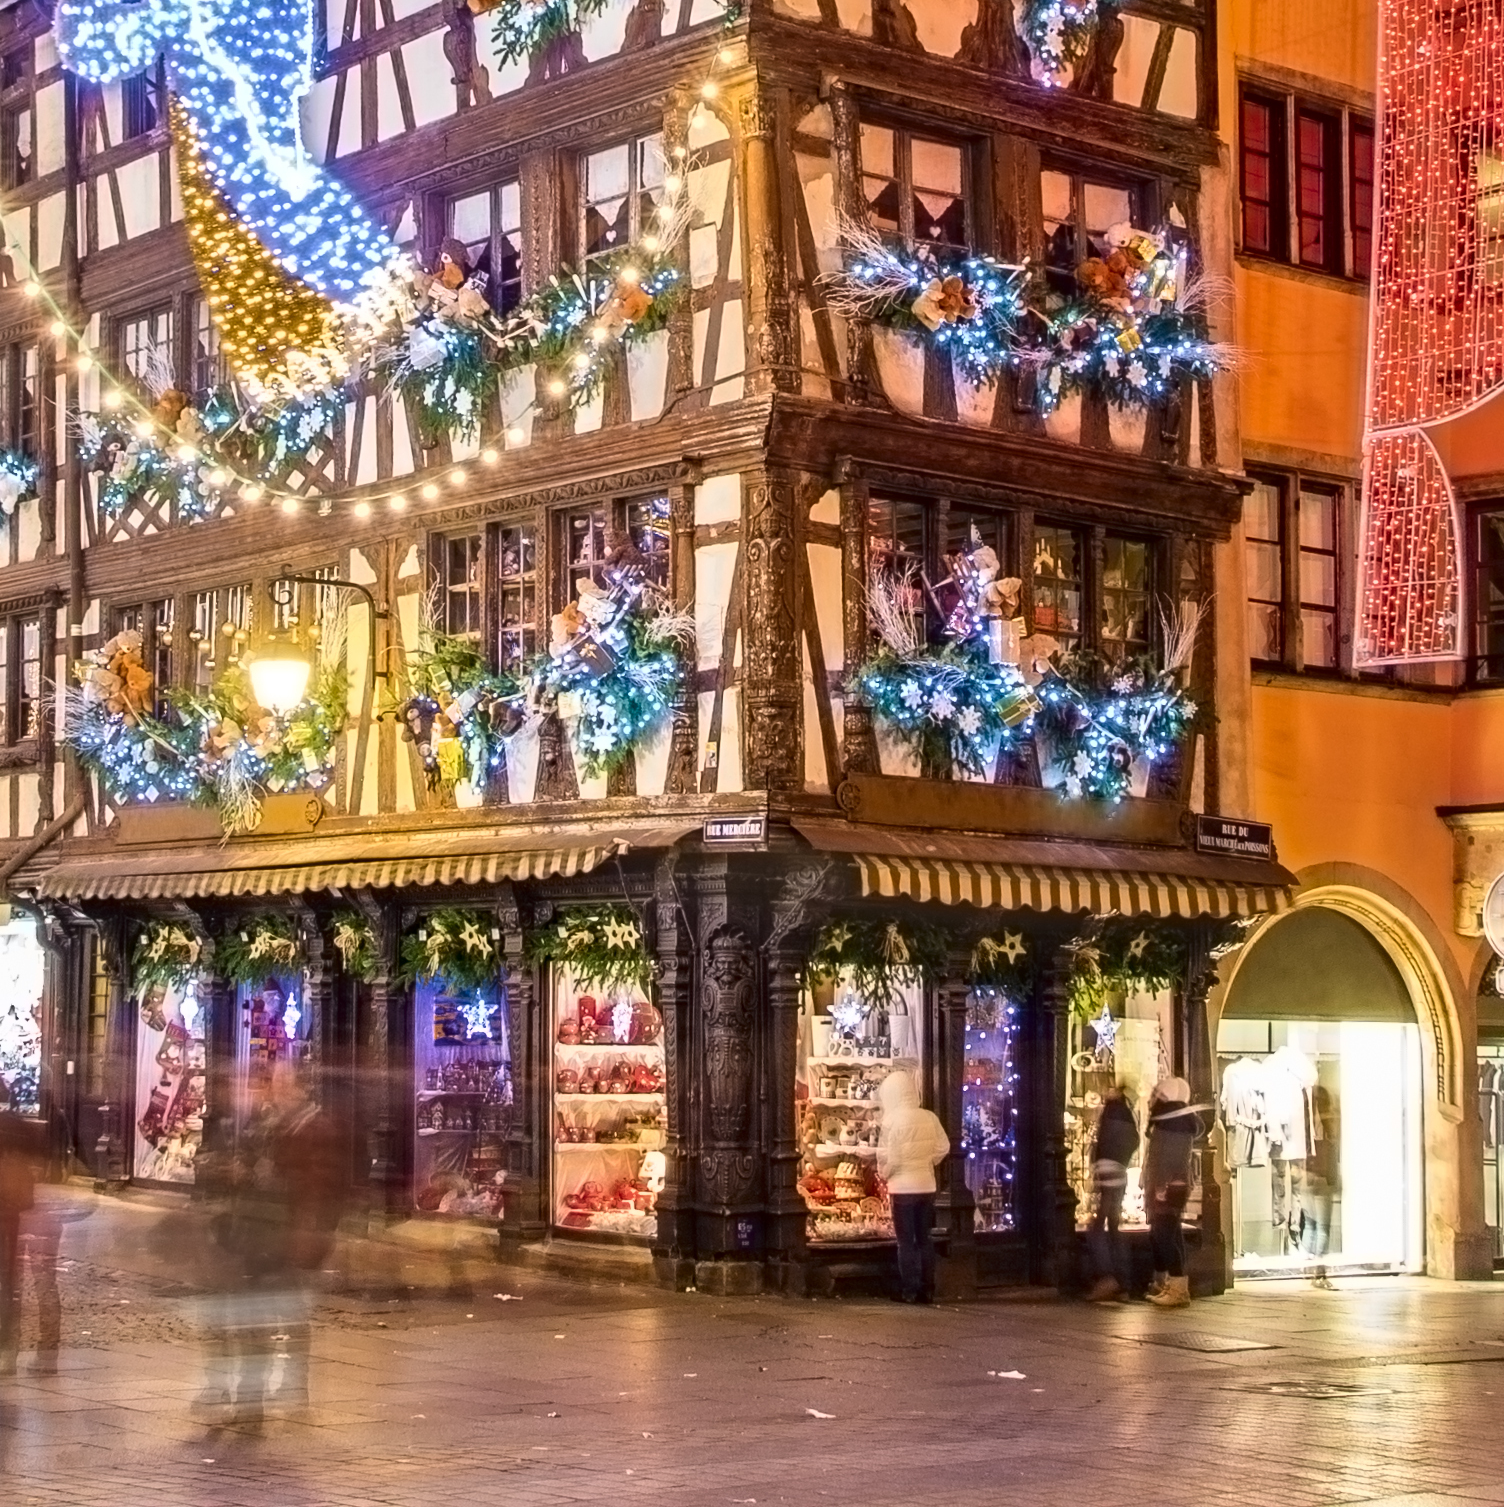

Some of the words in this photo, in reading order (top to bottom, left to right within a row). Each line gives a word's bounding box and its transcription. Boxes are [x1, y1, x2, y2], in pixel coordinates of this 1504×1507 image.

[707, 824, 721, 836] RUE
[1222, 824, 1237, 836] RUE
[1238, 826, 1249, 837] DU
